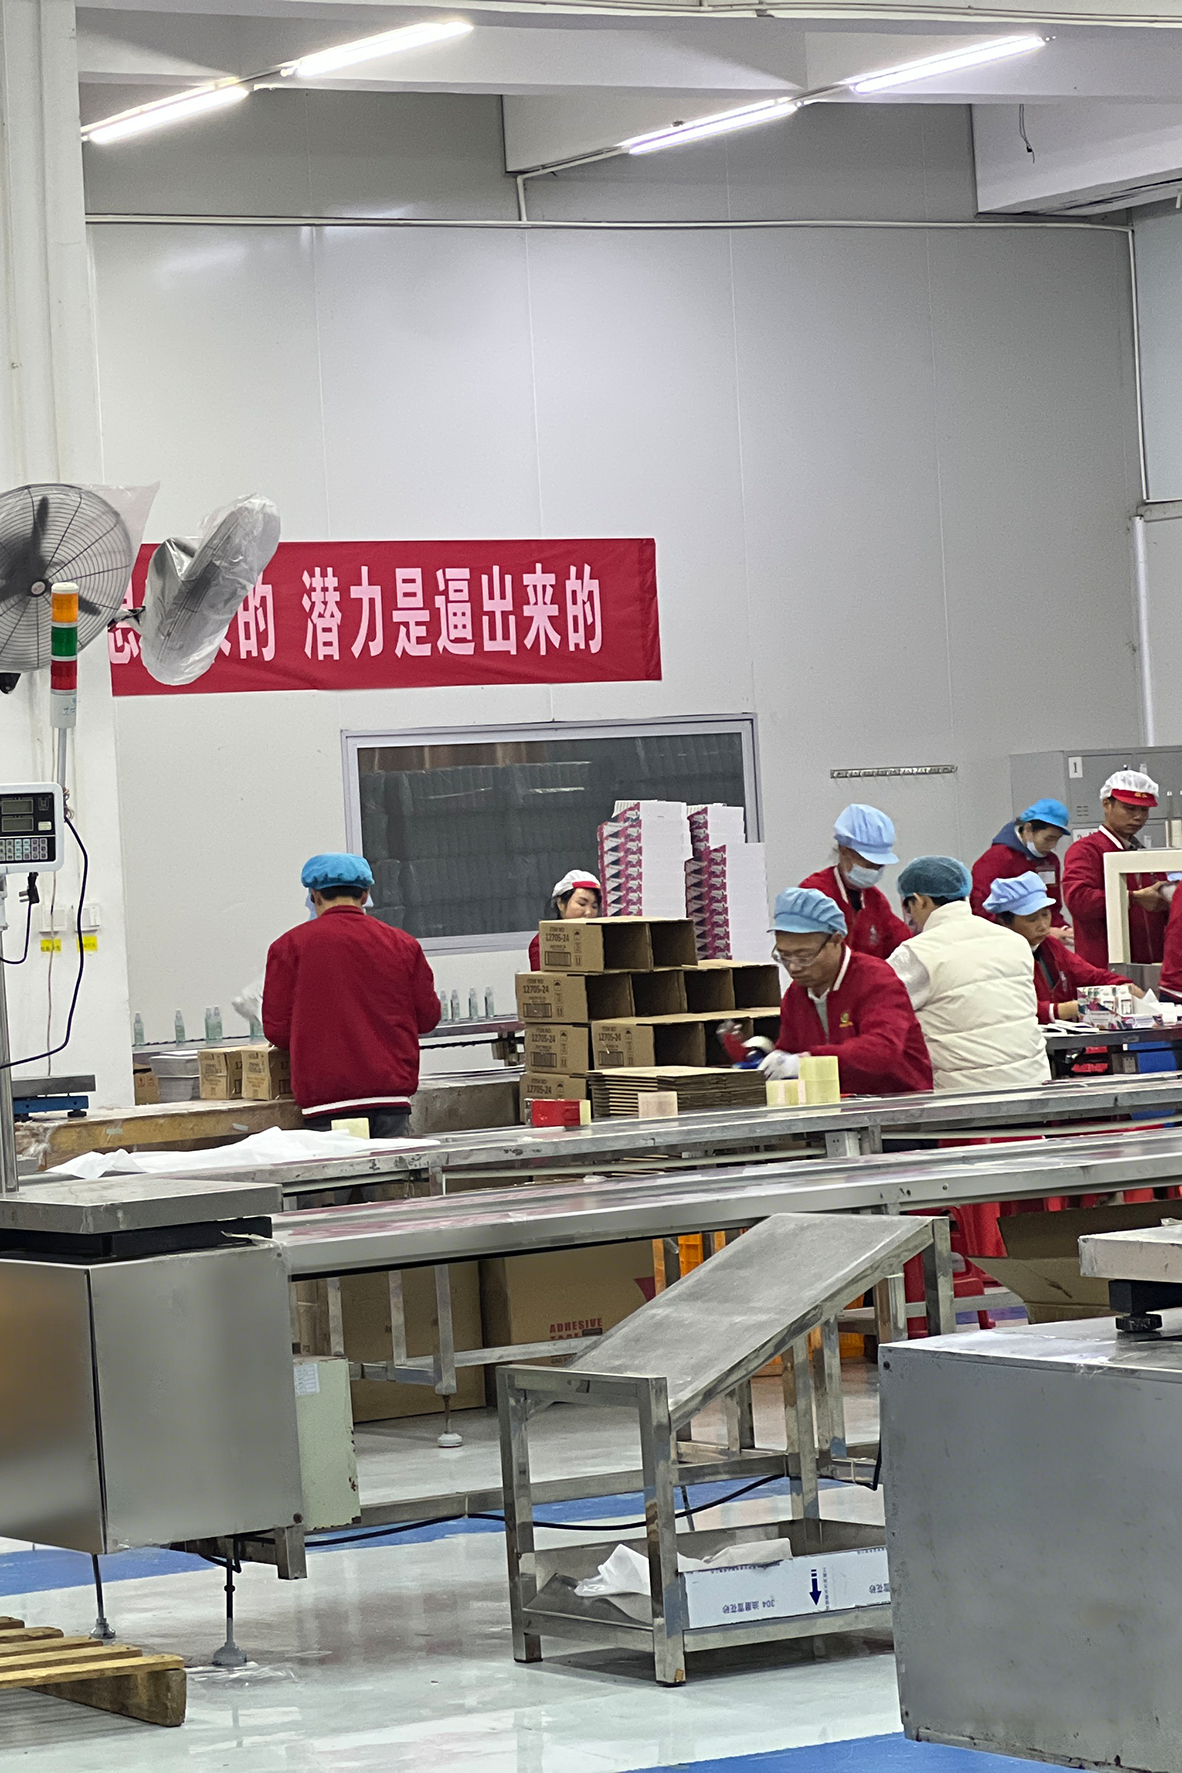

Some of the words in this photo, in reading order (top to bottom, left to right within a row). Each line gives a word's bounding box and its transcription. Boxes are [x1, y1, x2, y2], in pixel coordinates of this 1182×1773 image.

[302, 563, 603, 660] 潜力是逼出来的
[550, 1318, 602, 1333] ADHESIVE
[762, 1598, 775, 1609] 304
